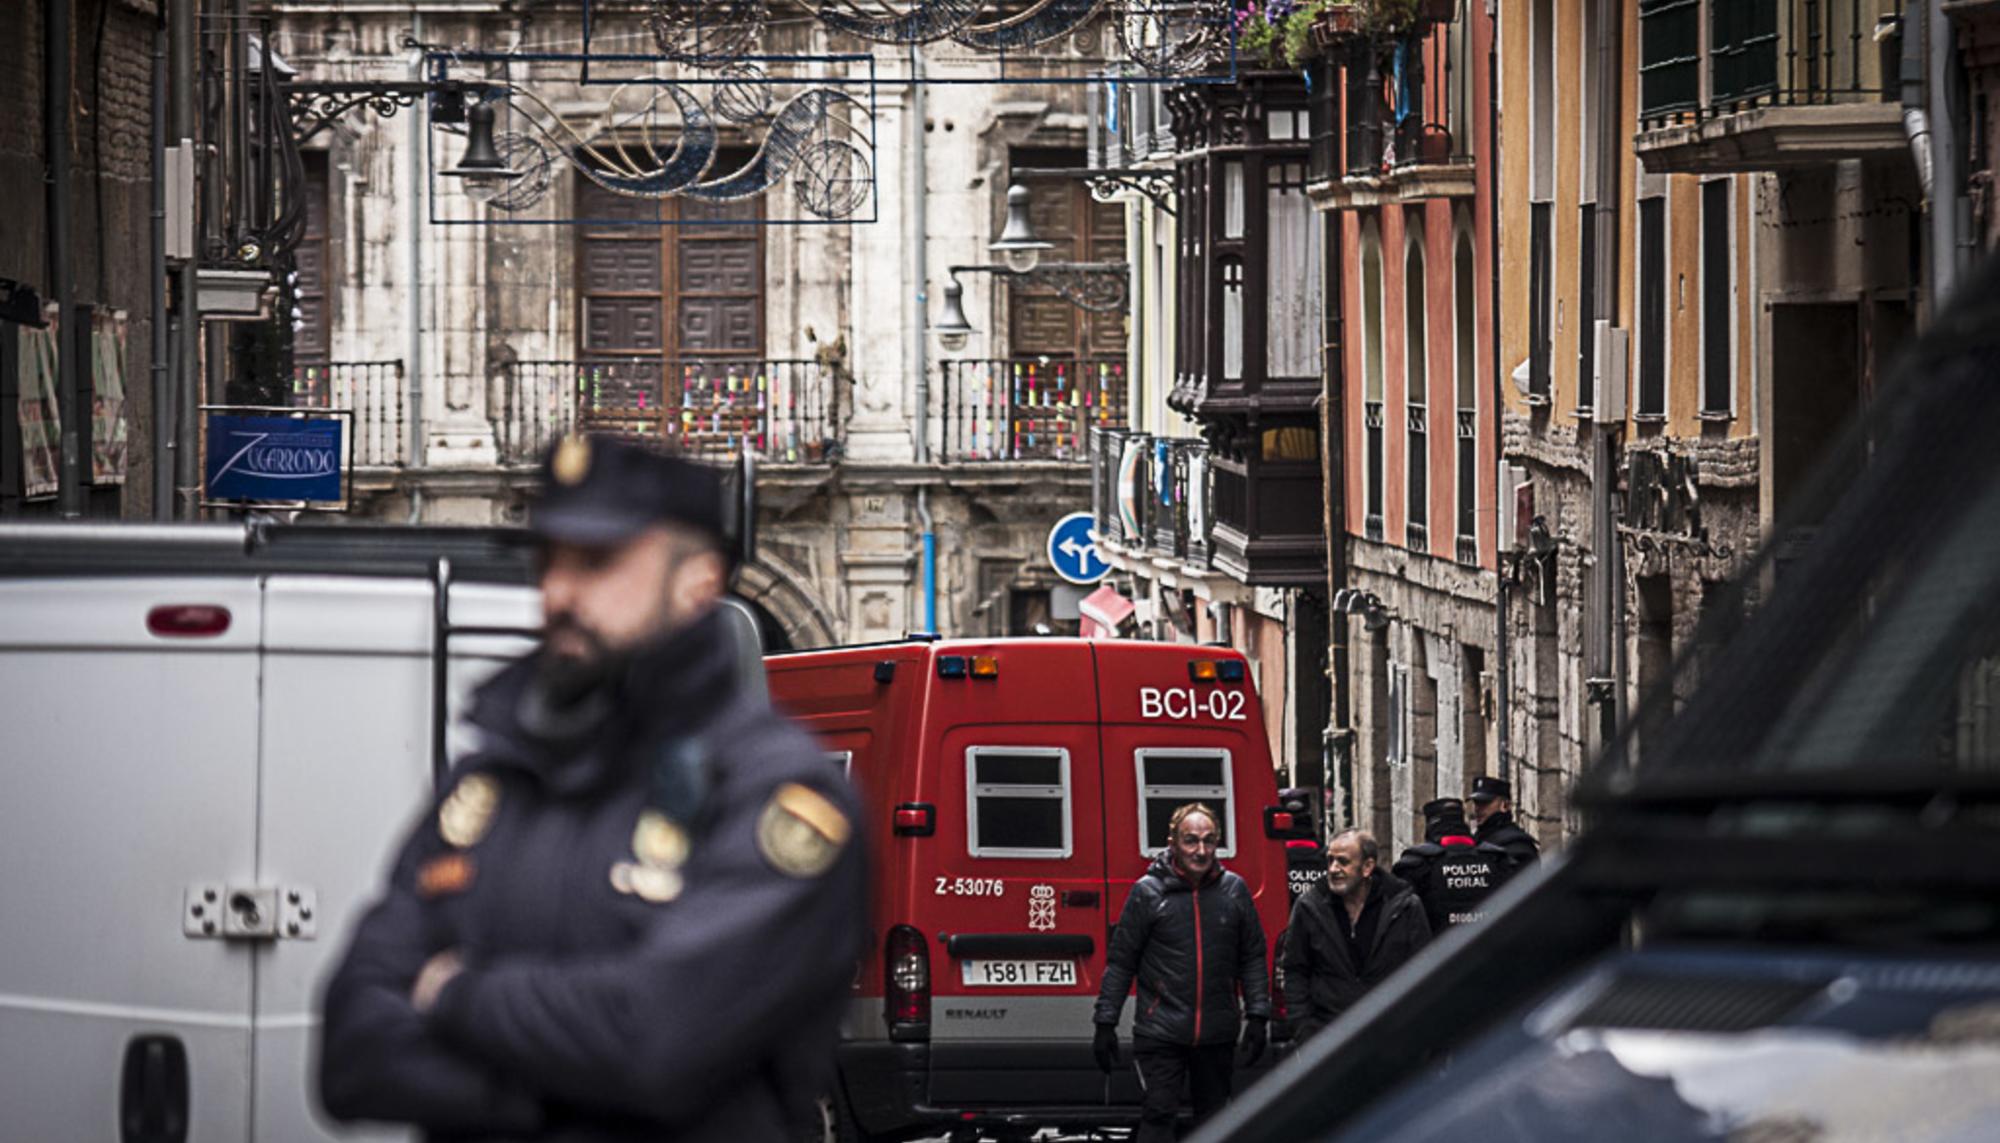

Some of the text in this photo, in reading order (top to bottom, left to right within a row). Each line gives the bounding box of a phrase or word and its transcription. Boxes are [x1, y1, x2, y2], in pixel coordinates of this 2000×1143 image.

[1140, 687, 1247, 720] BCI-02
[934, 876, 1004, 897] Z-53076
[1447, 876, 1489, 889] FORAL
[983, 962, 1073, 983] 1581 FZH
[944, 1008, 1009, 1020] RENAULT
